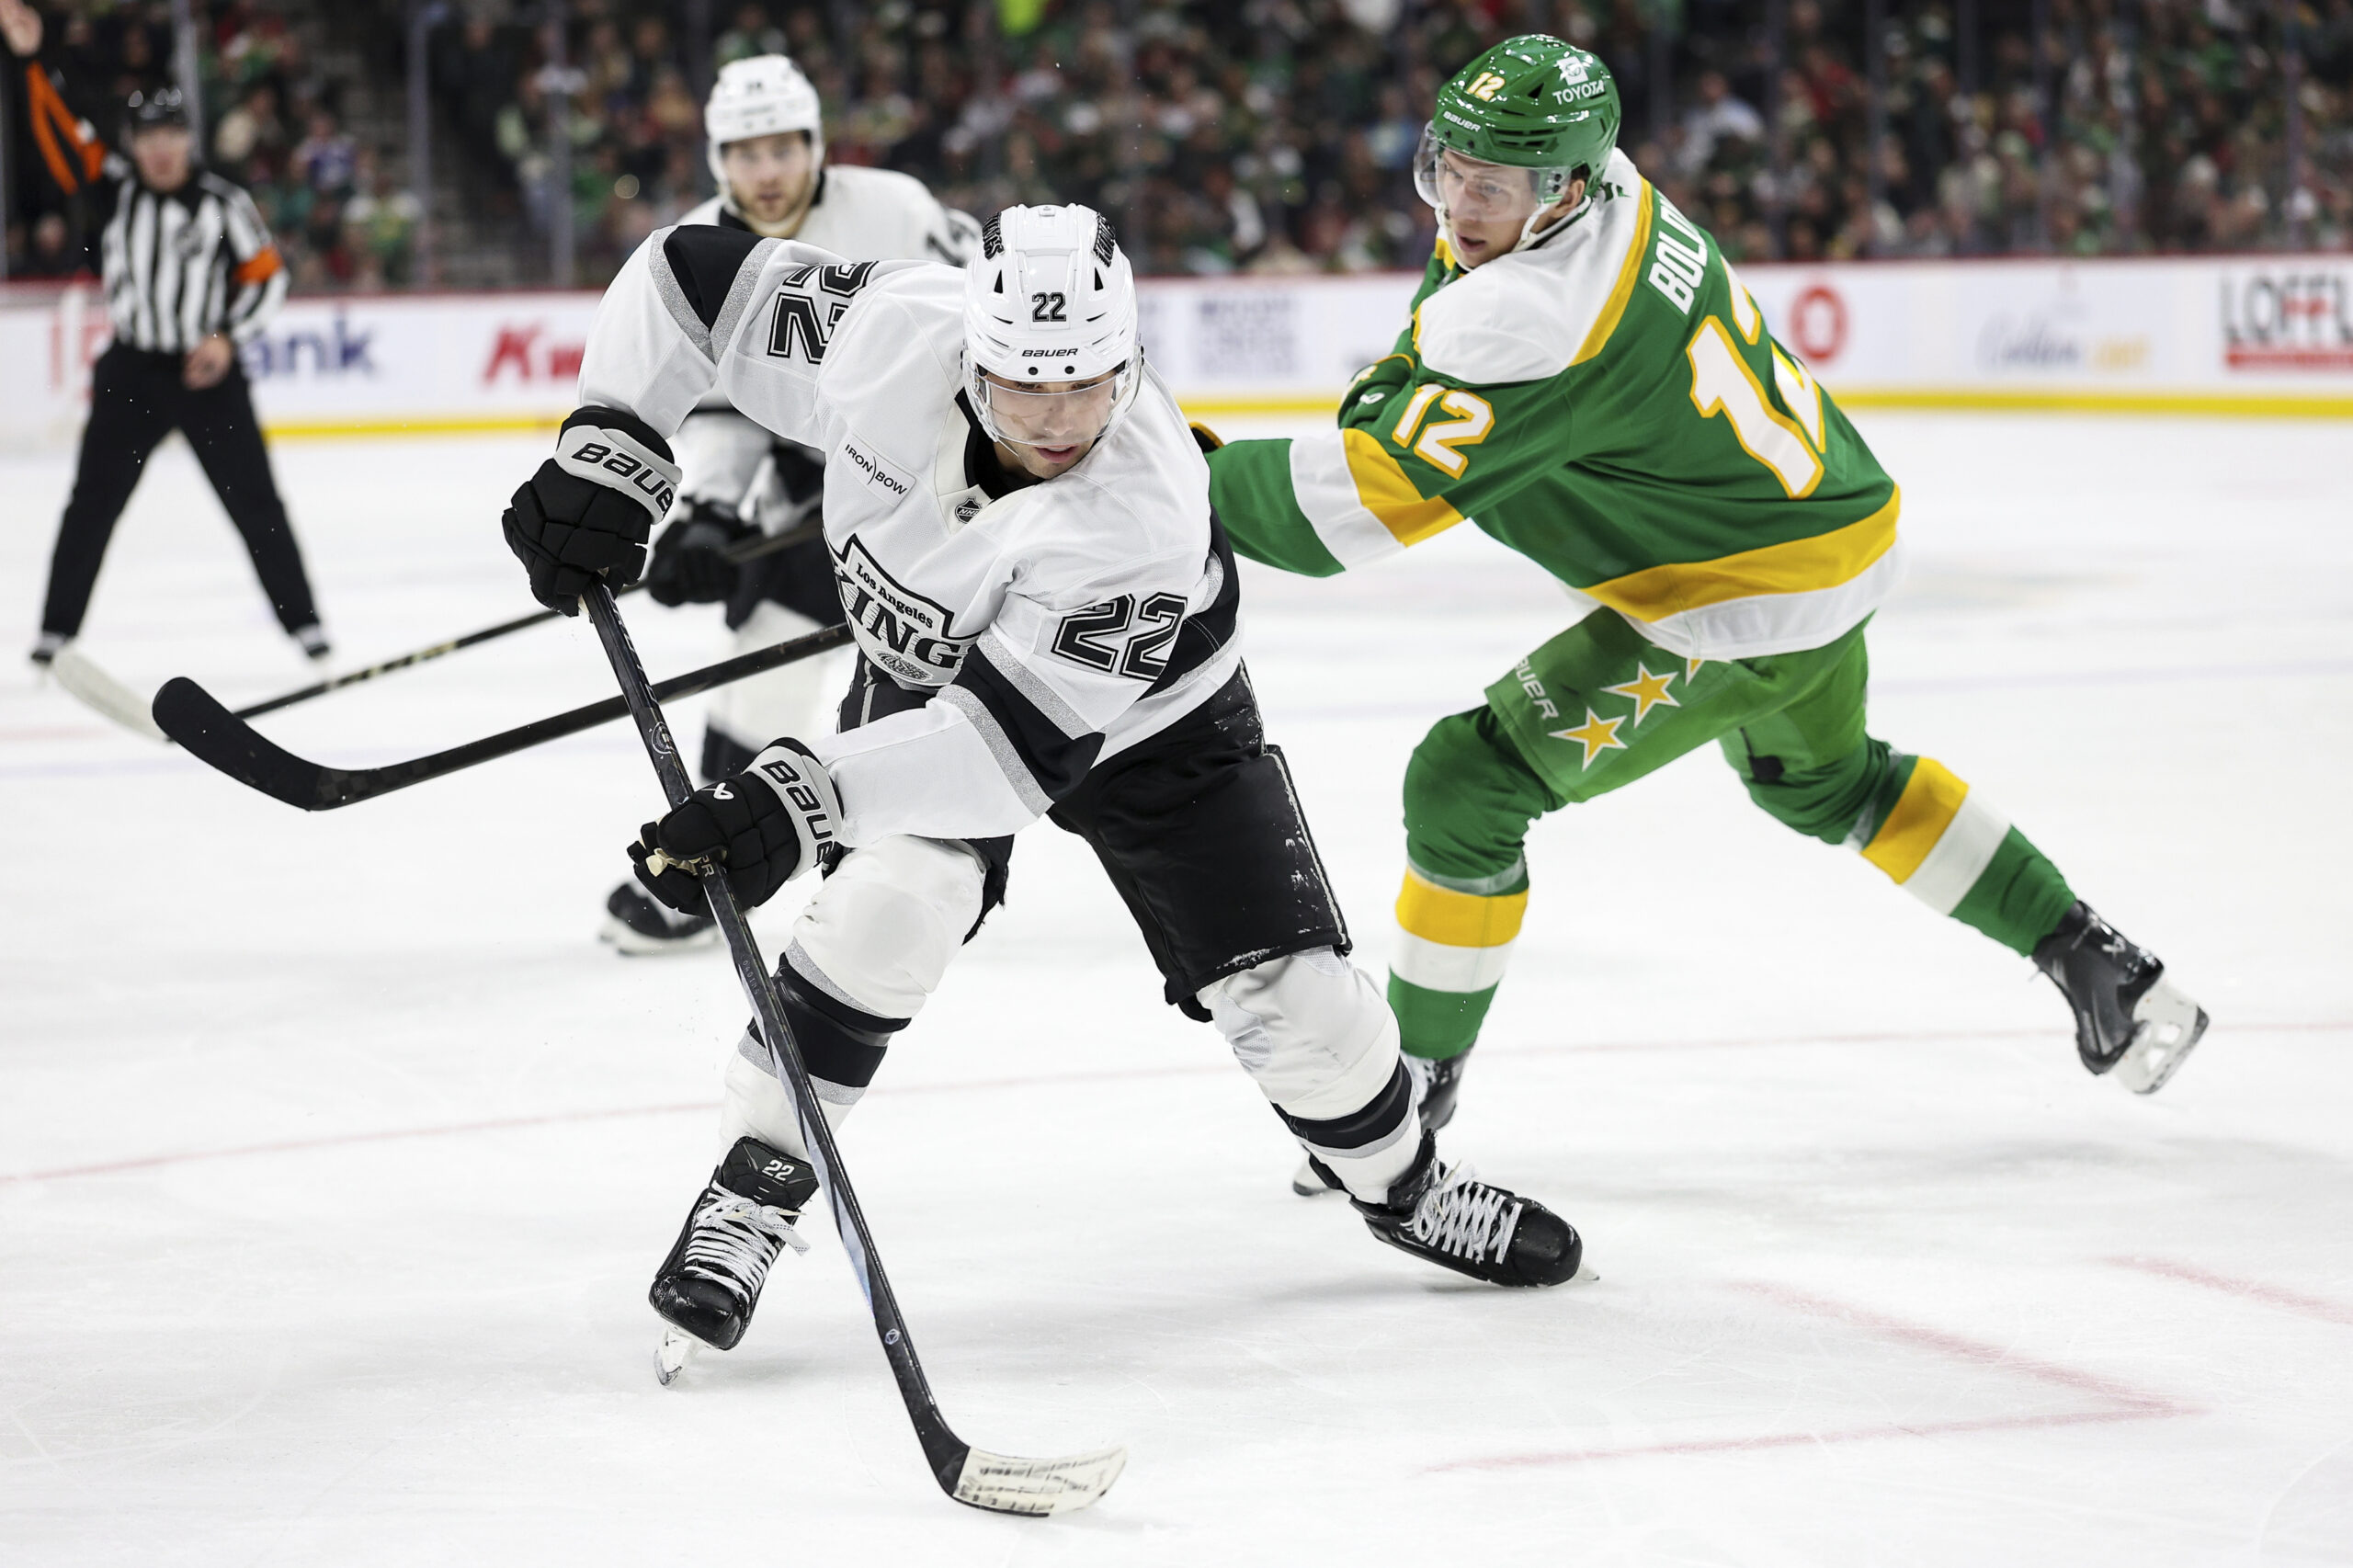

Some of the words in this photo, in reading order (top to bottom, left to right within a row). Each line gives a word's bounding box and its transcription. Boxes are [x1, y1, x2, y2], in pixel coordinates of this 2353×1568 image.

[1467, 72, 1506, 101] 12
[1552, 80, 1606, 105] TOYOTA
[1032, 292, 1066, 322] 22
[1392, 382, 1495, 480] 12
[571, 442, 674, 515] BAUE
[845, 444, 874, 473] IRON
[874, 471, 907, 495] BOW
[856, 562, 877, 590] Los
[877, 585, 934, 629] Angeles
[1051, 591, 1188, 682] 22
[760, 759, 833, 866] BAUE
[762, 1159, 794, 1181] 22
